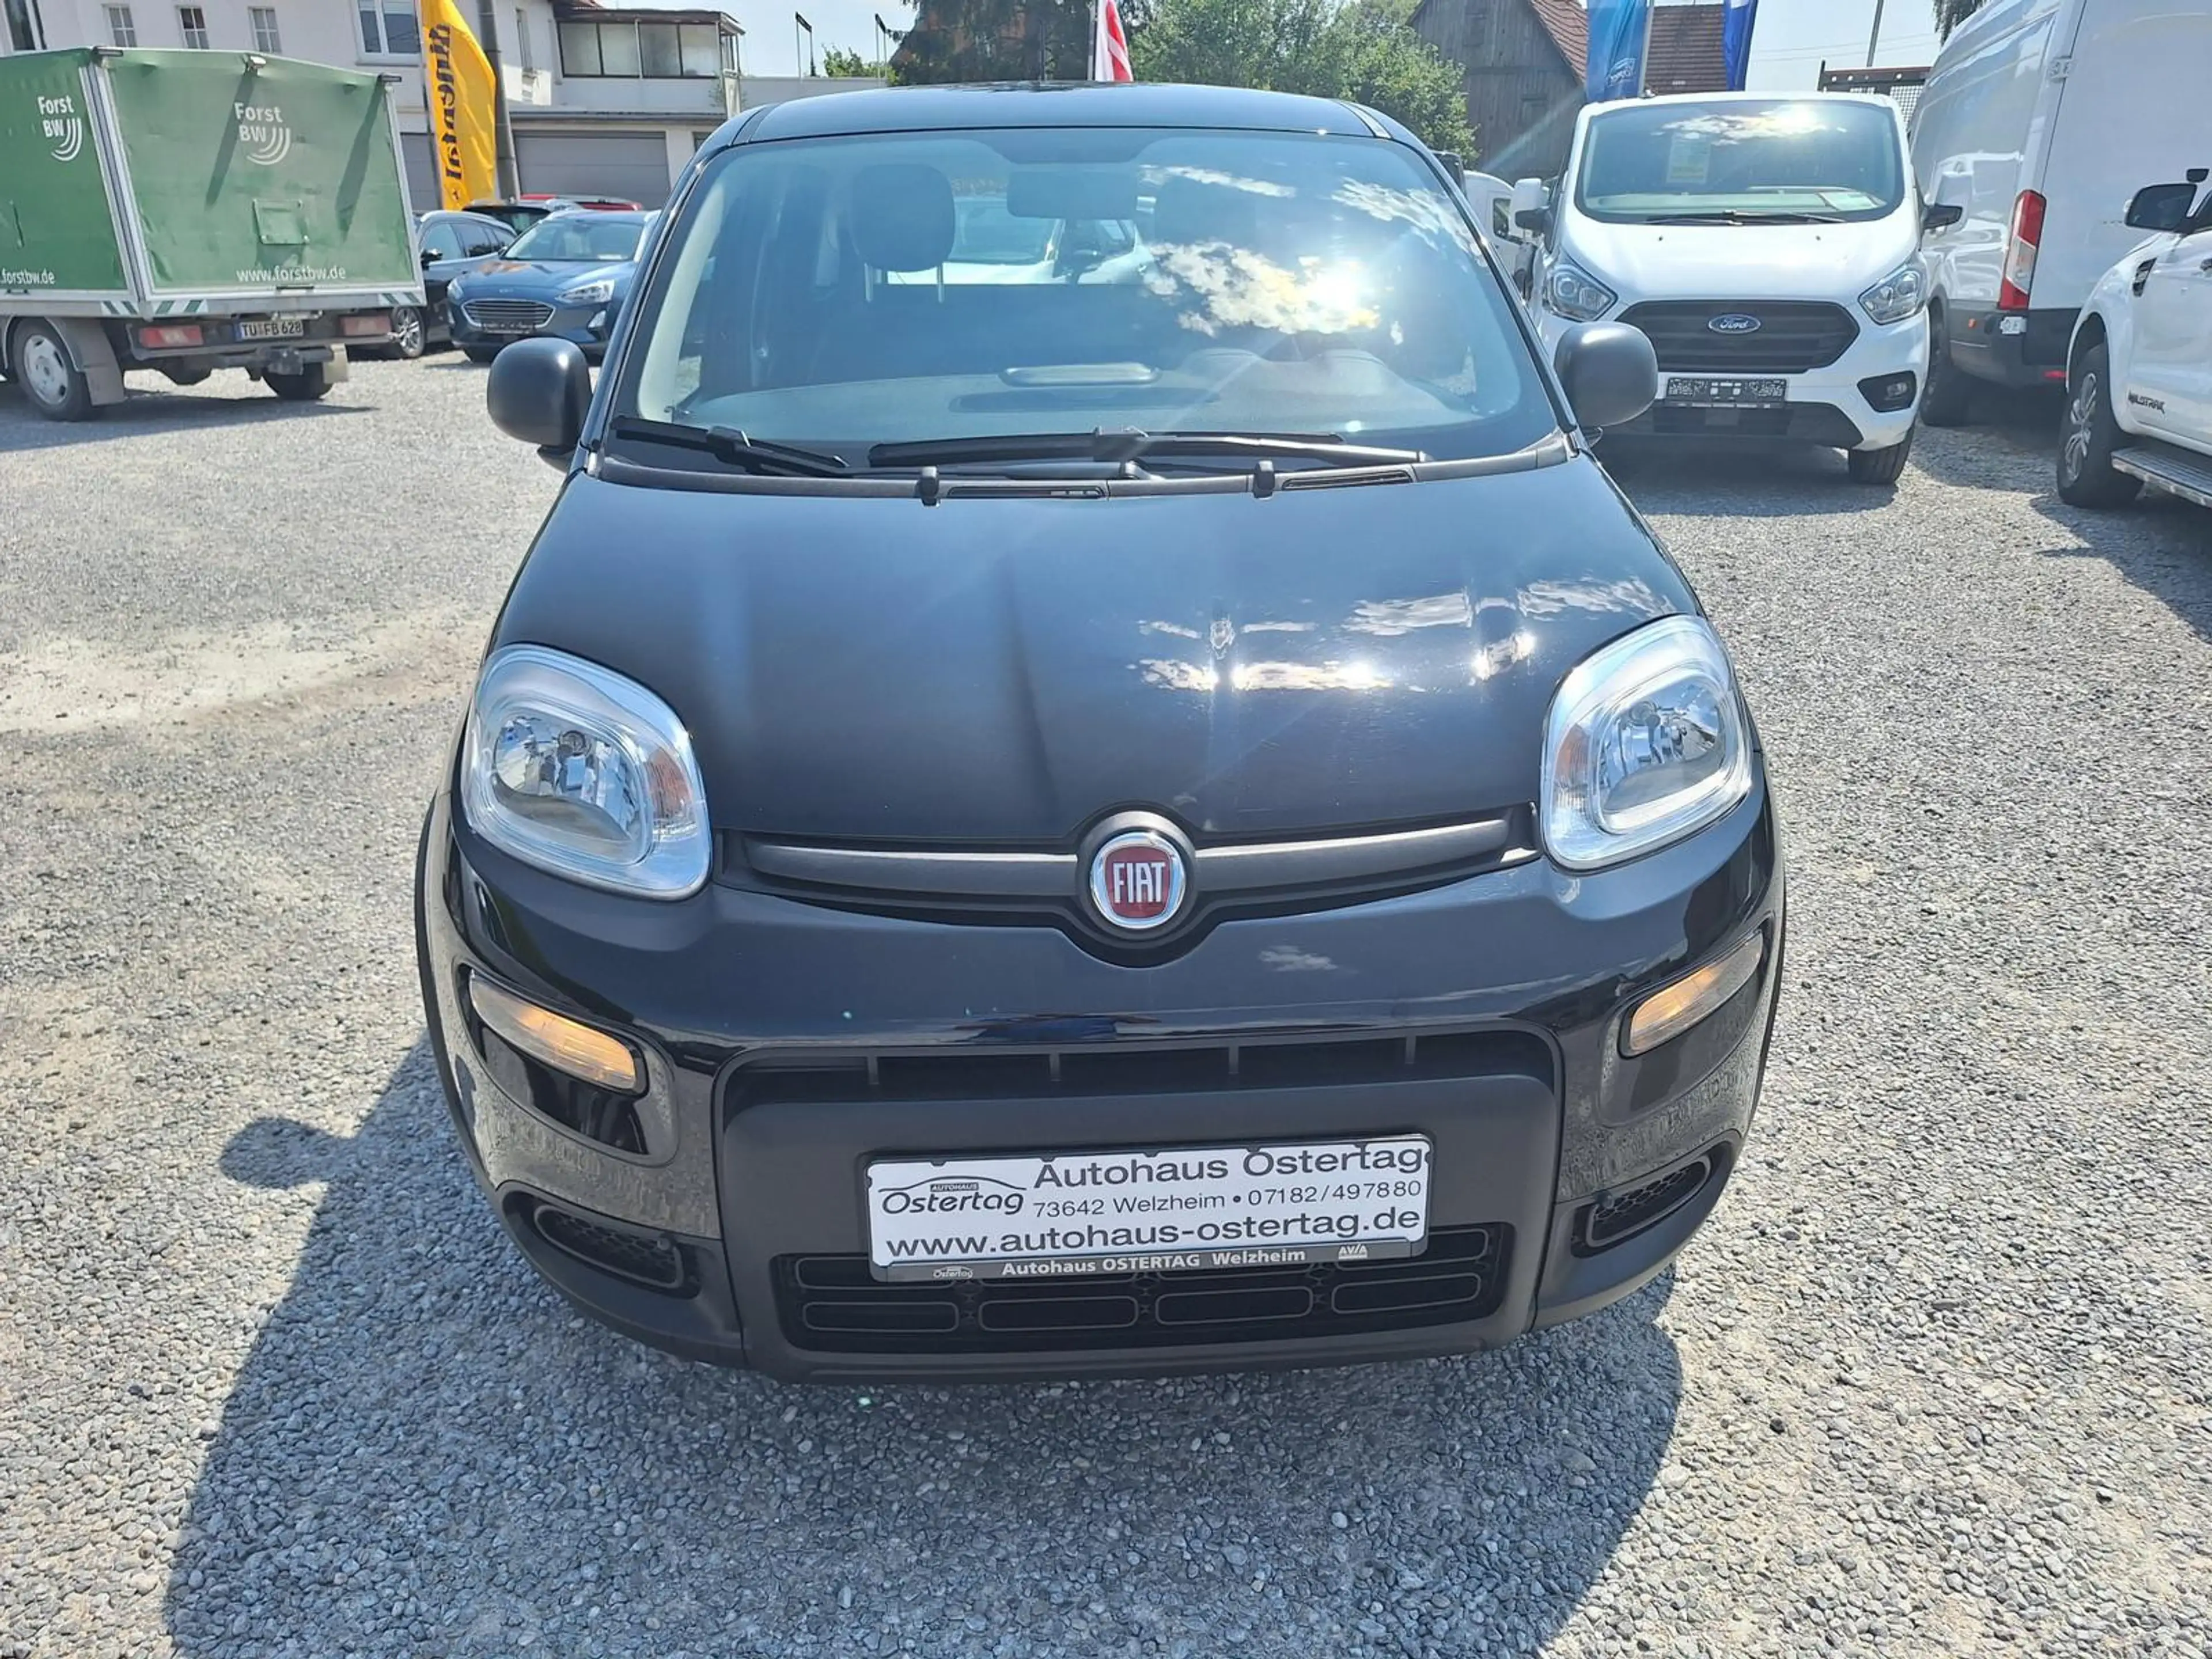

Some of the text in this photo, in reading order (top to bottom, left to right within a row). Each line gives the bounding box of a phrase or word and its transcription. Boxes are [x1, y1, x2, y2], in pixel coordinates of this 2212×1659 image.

[37, 94, 75, 115] Forst
[234, 101, 283, 123] Forst
[43, 119, 65, 138] BW
[239, 124, 266, 142] BW
[236, 264, 346, 282] www.forstbw.de
[241, 321, 302, 337] TU FB 628
[1719, 318, 1749, 329] Ford
[1113, 861, 1166, 903] FIAT
[1033, 1146, 1423, 1188] Autohaus Ostertag
[931, 1183, 979, 1191] AUTOHAUS
[881, 1191, 1024, 1215] Ostertag
[1033, 1180, 1421, 1218] 73642 Welzheim 07182/497880
[886, 1206, 1420, 1257] www.autohaus-ostertag.de
[933, 1267, 974, 1278] Ostertag
[1002, 1248, 1306, 1276] Autohaus OSTERTAG Welzheim
